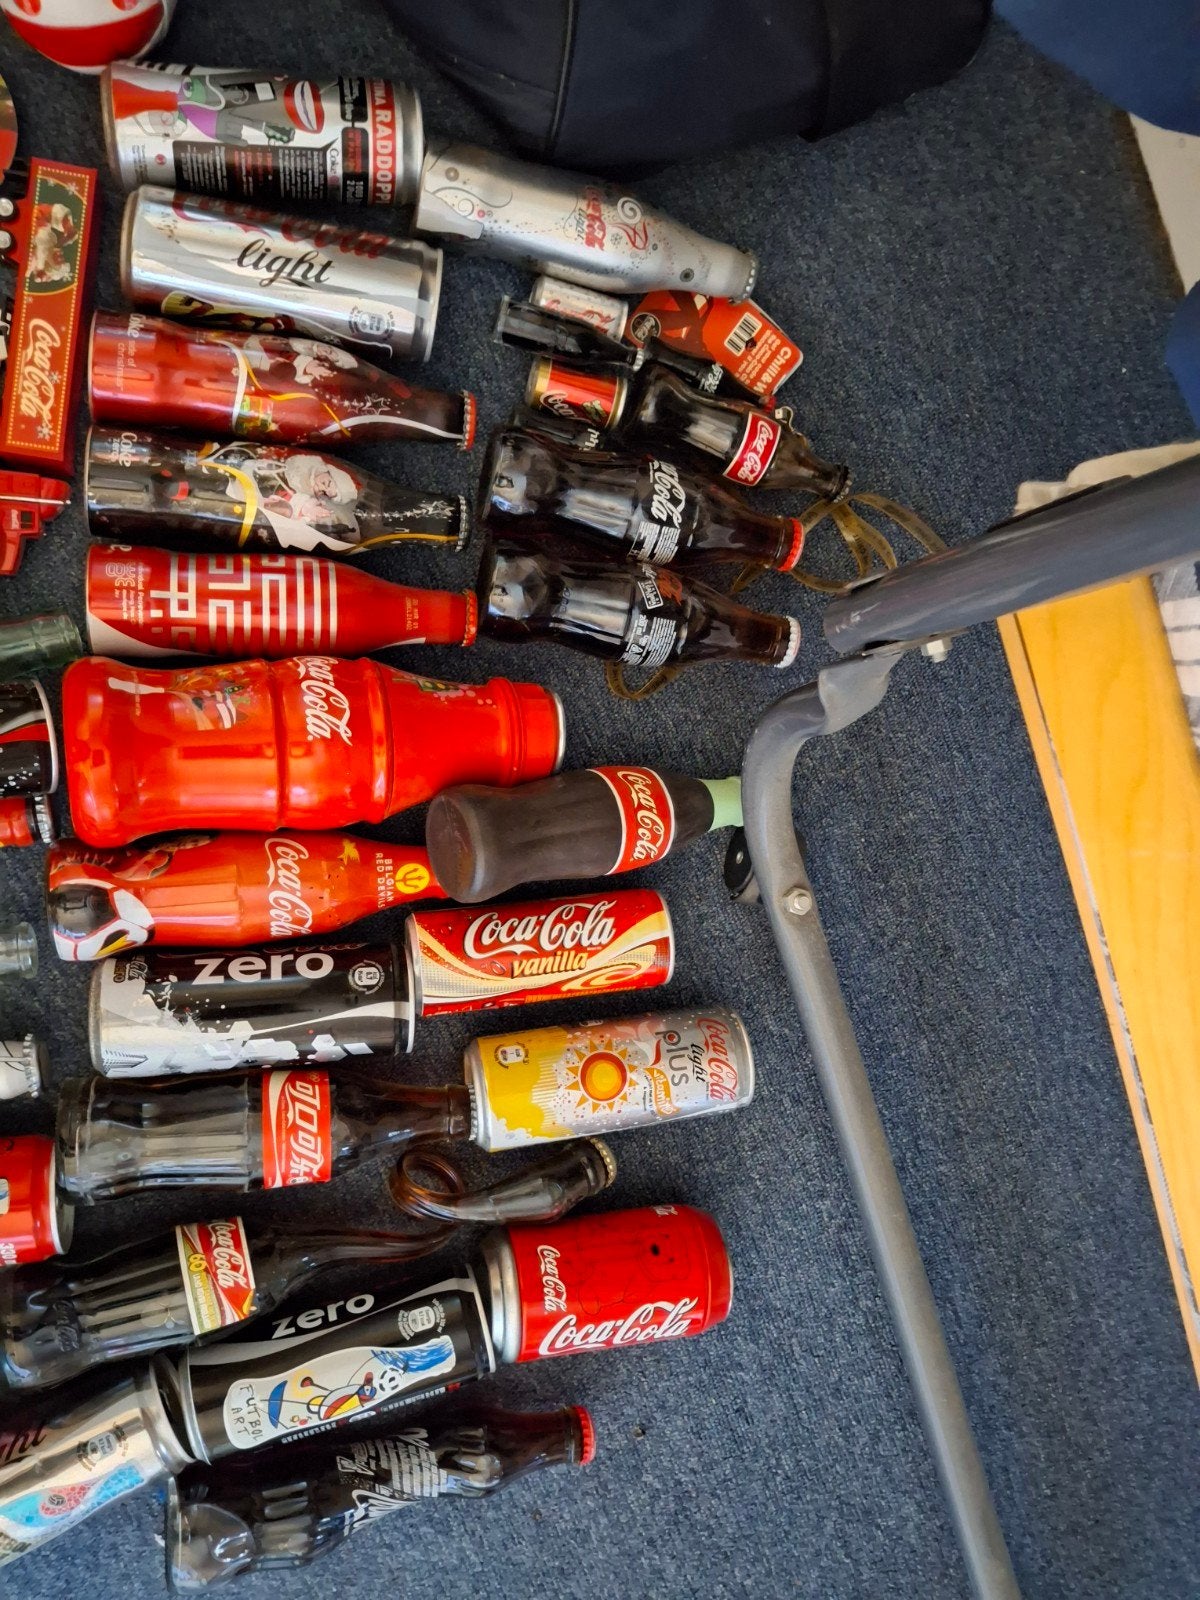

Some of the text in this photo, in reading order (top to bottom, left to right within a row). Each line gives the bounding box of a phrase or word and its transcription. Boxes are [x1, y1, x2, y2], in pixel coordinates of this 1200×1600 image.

[231, 238, 334, 288] light
[18, 317, 59, 423] Coca-Cola
[118, 432, 138, 468] Coke
[737, 420, 773, 482] Coca-Cola
[293, 655, 353, 747] Coca-Cola
[615, 770, 666, 862] Coca-Cola
[264, 837, 314, 938] Coca-Cola
[374, 852, 386, 909] RED DEVILS
[384, 858, 395, 903] BELGIAN
[464, 899, 618, 960] Coca-Cola
[191, 951, 335, 986] zero
[510, 949, 590, 979] vanilla
[654, 1030, 690, 1087] plus
[687, 1042, 707, 1083] light
[696, 1017, 738, 1102] Coca-Cola
[188, 1251, 207, 1274] 60
[207, 1217, 249, 1290] Coca-Cola
[536, 1244, 567, 1314] Coca-Cola
[270, 1293, 376, 1340] zero
[538, 1296, 699, 1356] Coca-Cola
[232, 1404, 251, 1439] ART
[240, 1384, 266, 1443] FUTBOL
